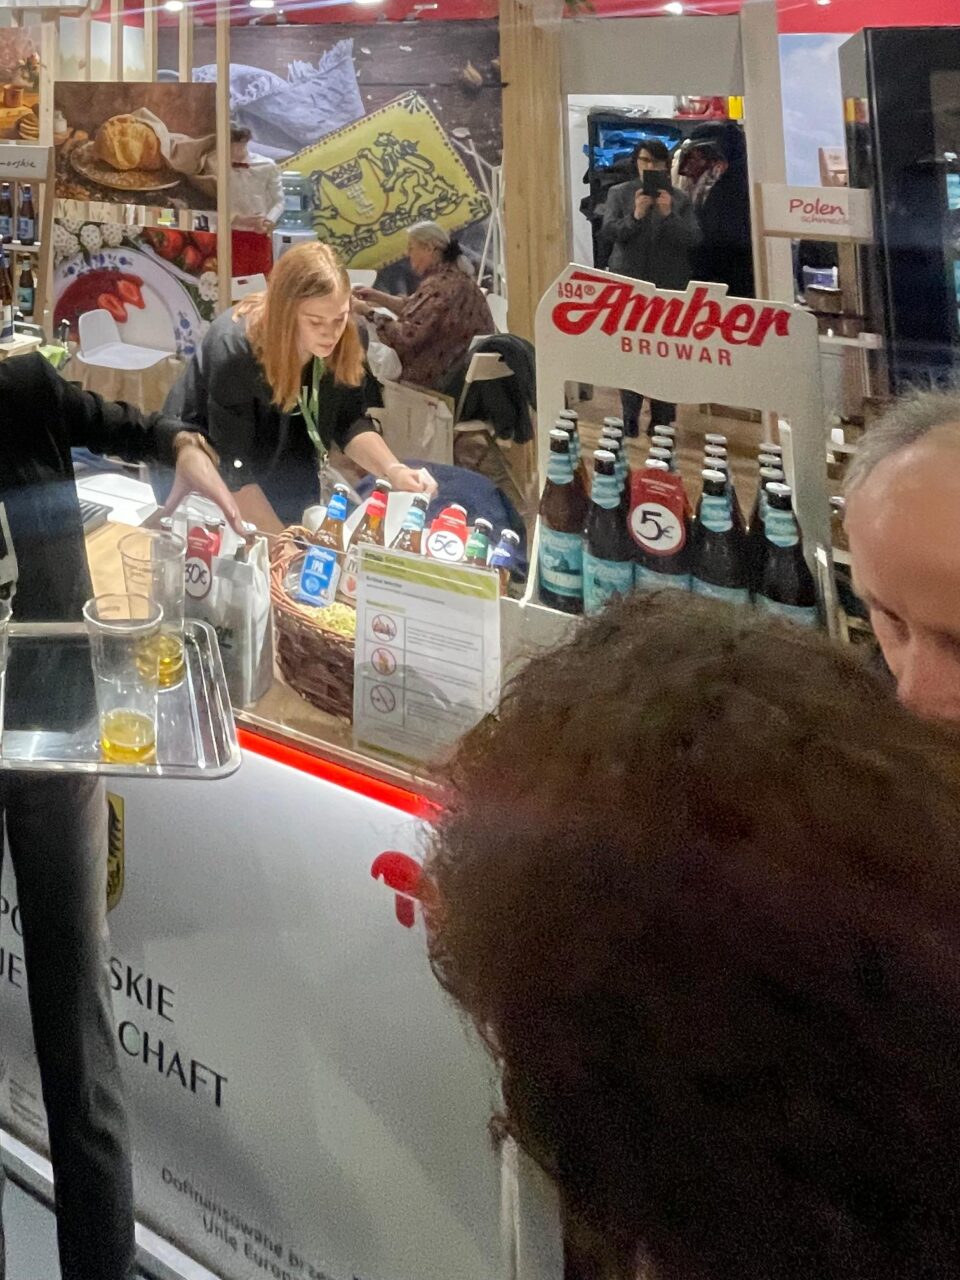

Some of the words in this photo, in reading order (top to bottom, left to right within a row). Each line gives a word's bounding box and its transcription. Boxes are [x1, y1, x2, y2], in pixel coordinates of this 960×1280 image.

[789, 197, 845, 216] Polen
[551, 271, 792, 347] Amber
[620, 336, 733, 367] BROWAR
